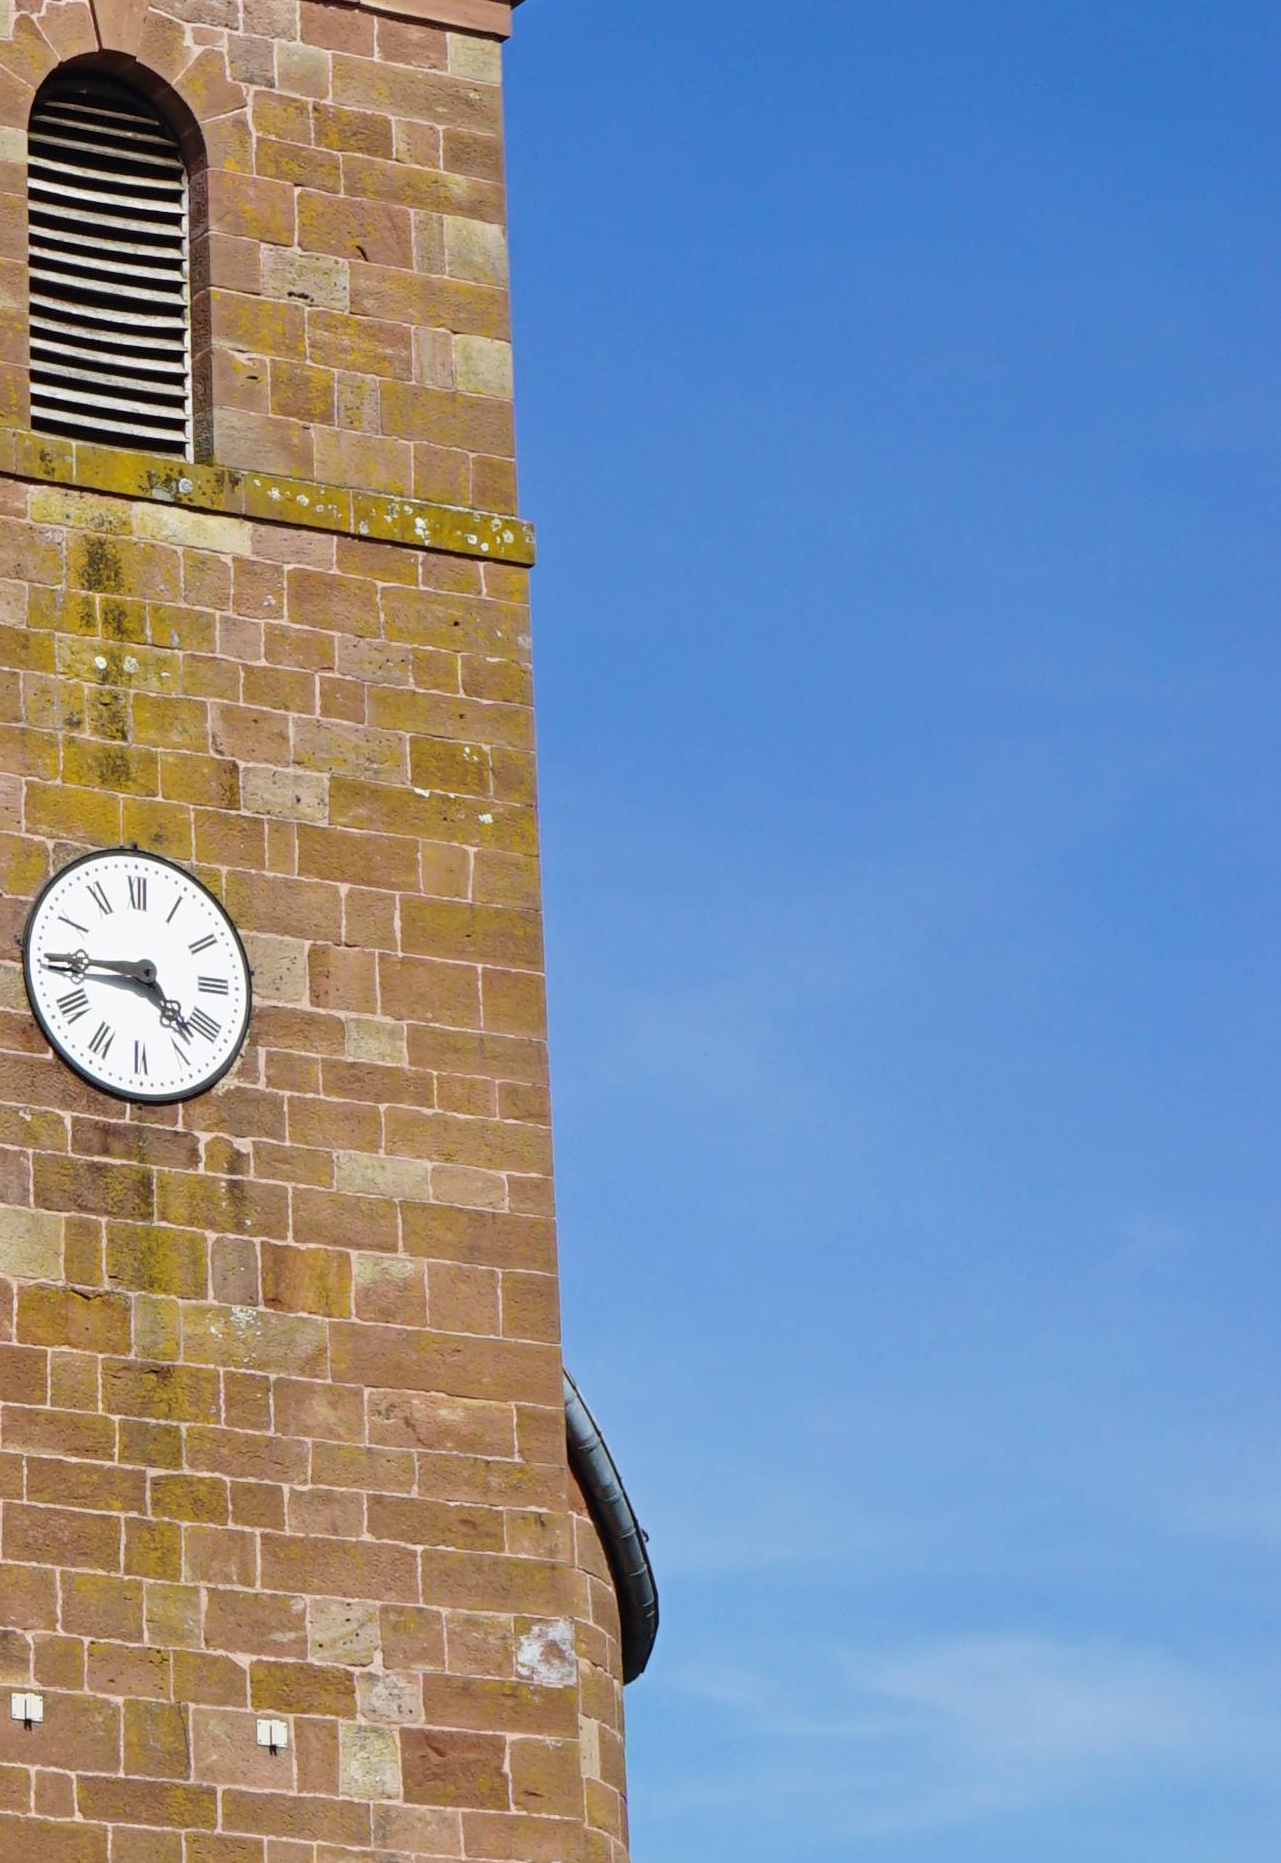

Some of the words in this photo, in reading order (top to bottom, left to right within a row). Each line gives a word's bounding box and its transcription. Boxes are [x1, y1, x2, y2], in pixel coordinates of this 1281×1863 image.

[85, 881, 114, 919] XI
[126, 875, 147, 911] XII
[188, 933, 218, 955] II
[198, 975, 229, 996] III
[56, 988, 93, 1025] VIII
[185, 1005, 222, 1043] IIII
[87, 1020, 116, 1060] VII
[134, 1040, 148, 1076] VI
